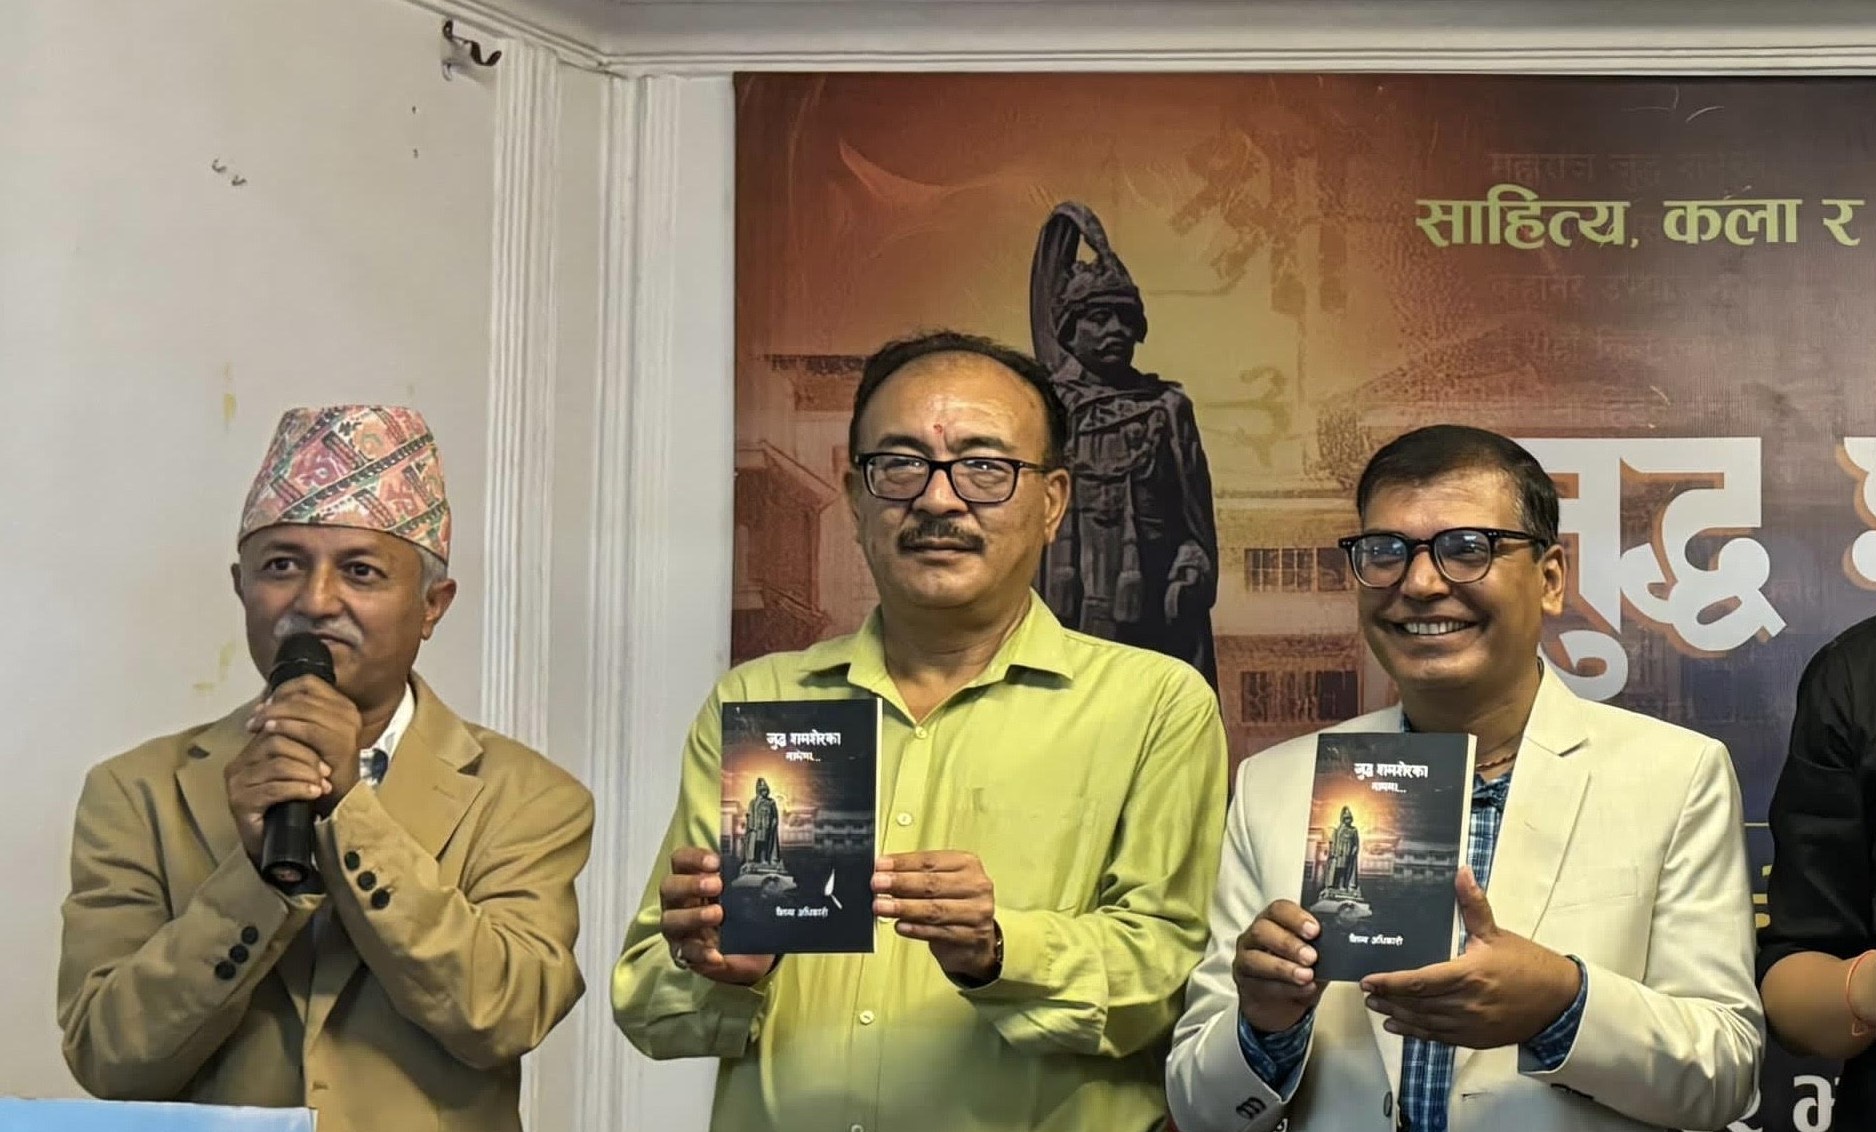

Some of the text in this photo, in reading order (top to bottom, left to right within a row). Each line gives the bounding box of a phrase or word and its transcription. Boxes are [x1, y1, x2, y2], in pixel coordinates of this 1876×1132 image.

[1415, 183, 1640, 250] साहित्य,
[1661, 198, 1804, 246] कला
[1823, 199, 1866, 246] र
